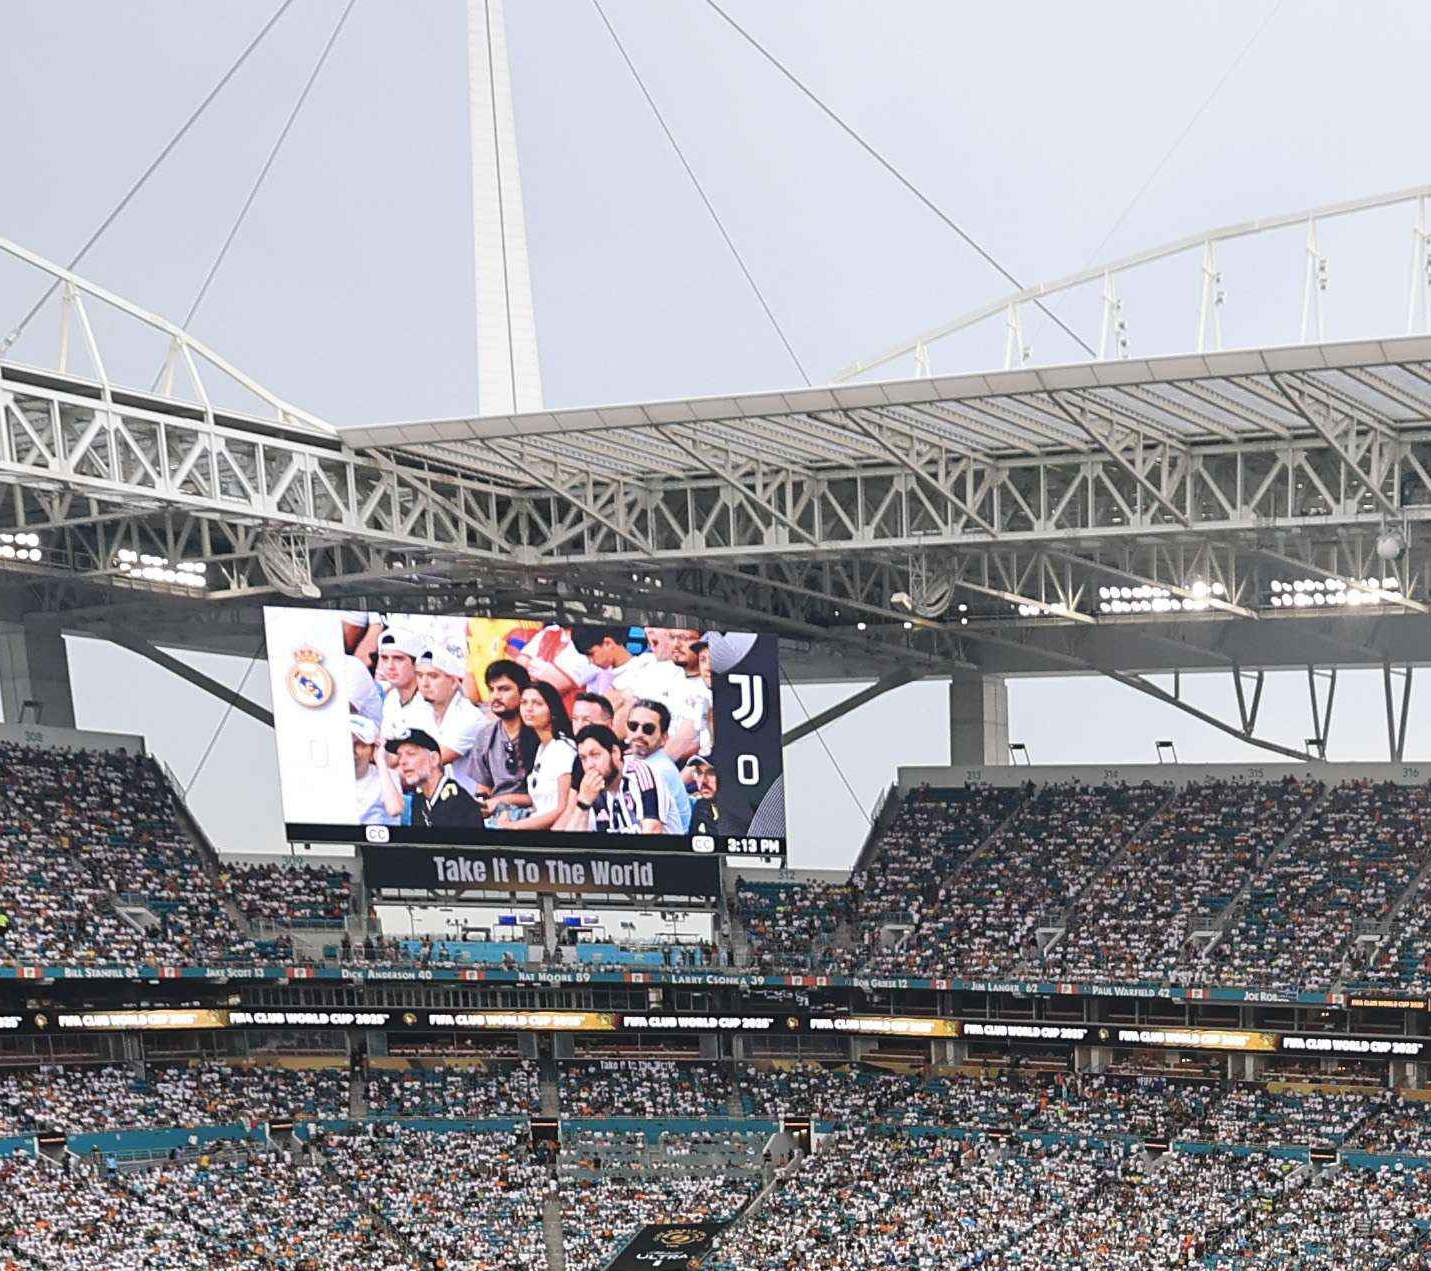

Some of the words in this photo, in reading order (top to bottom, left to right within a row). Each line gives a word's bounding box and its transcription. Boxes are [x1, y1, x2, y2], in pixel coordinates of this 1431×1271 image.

[760, 839, 780, 853] PM
[433, 856, 486, 883] Take
[492, 857, 508, 883] It
[513, 858, 539, 884] To
[545, 859, 585, 884] The
[591, 860, 653, 886] World
